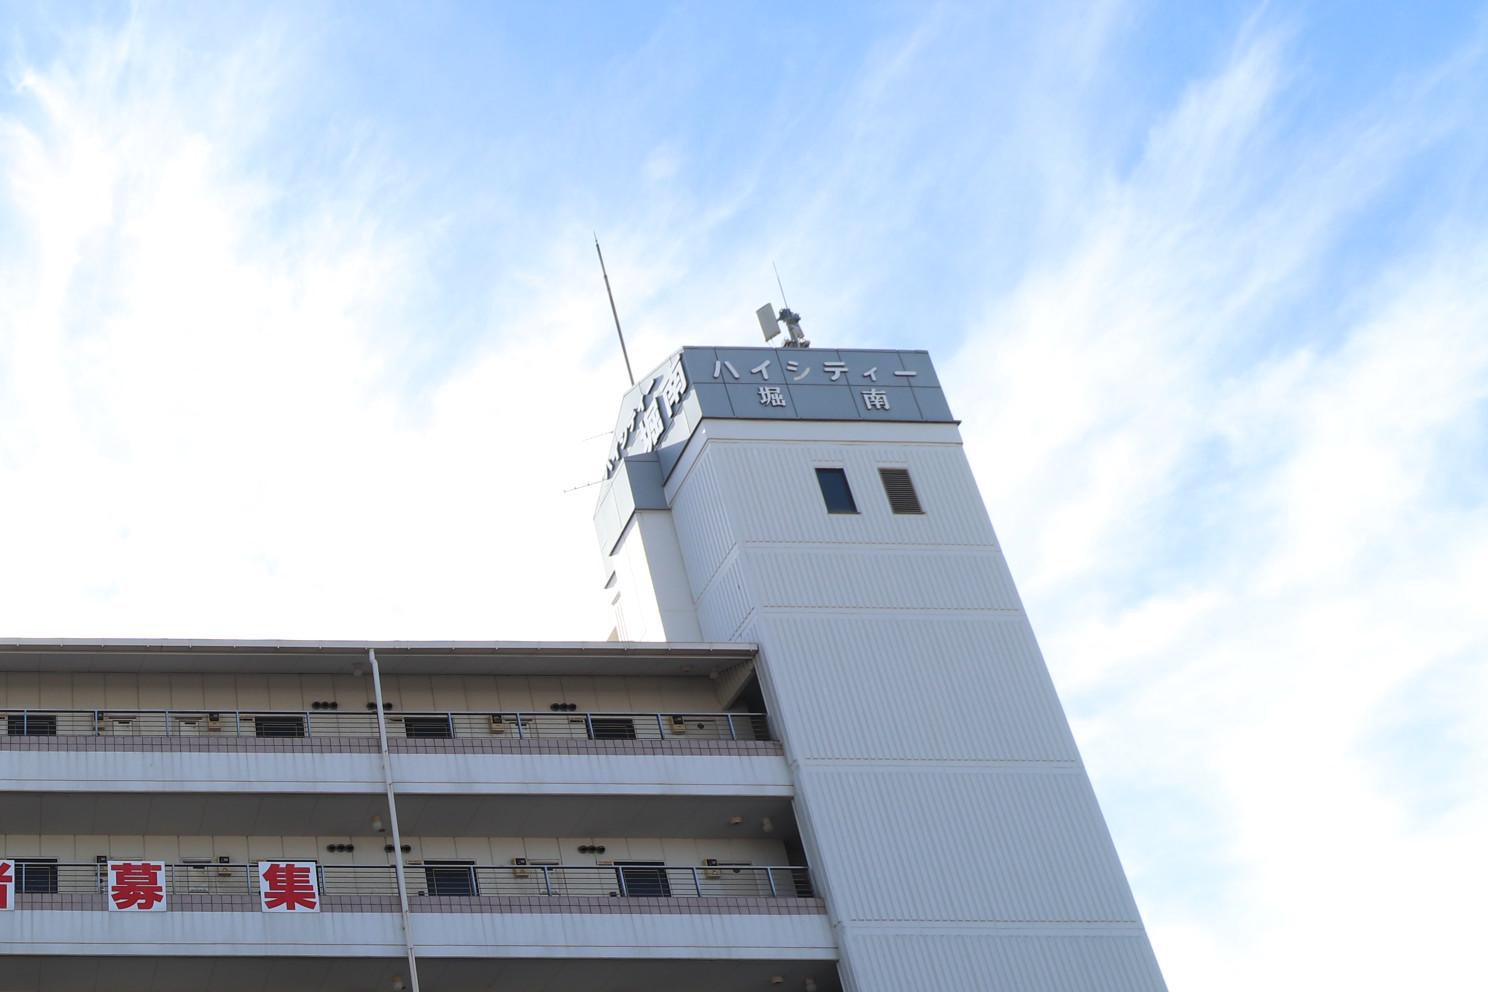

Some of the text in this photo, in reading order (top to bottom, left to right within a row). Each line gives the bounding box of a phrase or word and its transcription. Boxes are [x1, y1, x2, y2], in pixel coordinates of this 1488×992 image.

[713, 359, 918, 381] ハイシティー
